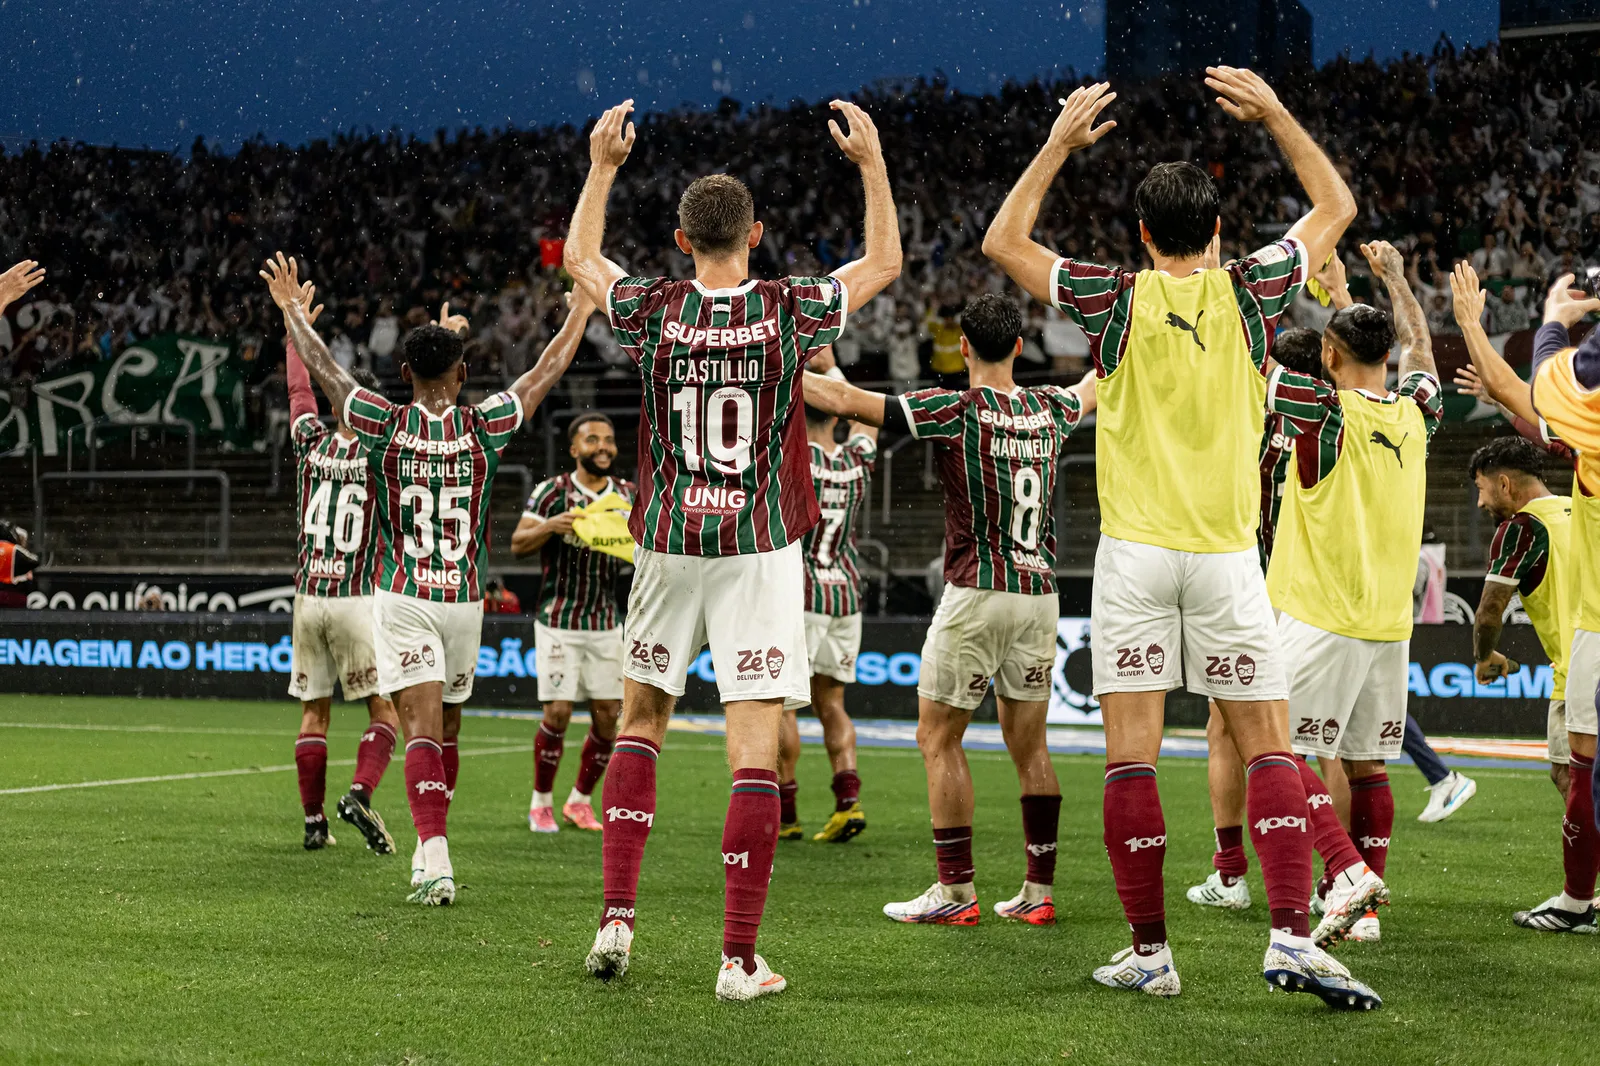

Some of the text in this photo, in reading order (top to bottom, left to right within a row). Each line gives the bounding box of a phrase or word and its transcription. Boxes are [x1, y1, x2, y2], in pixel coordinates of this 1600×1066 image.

[664, 319, 777, 347] SUPERBET
[675, 359, 759, 382] CASTILLO
[715, 391, 745, 399] predialnet
[980, 409, 1052, 430] SUPERBET
[672, 386, 754, 474] 19
[394, 430, 475, 455] SUPERBET
[402, 459, 471, 478] HERCULES
[684, 487, 746, 508] UNIG
[304, 480, 368, 553] 46
[681, 506, 722, 514] UNIVERSIDADE
[1011, 467, 1041, 550] 8
[400, 484, 473, 562] 35
[309, 558, 346, 575] UNIG
[1010, 550, 1049, 569] UNIG
[413, 567, 461, 585] UNIG
[138, 640, 191, 670] AO
[196, 635, 293, 673] HERÓ
[400, 649, 422, 668] Zé
[631, 639, 650, 663] Zé
[1116, 646, 1145, 670] Zé
[631, 659, 652, 670] DELIVERY
[736, 649, 764, 673] Zé
[1205, 655, 1233, 678] Zé
[736, 673, 764, 681] DELIVERY
[968, 673, 990, 692] Zé
[1025, 666, 1045, 682] Zé
[1117, 669, 1145, 678] DELIVERY
[1206, 677, 1234, 685] DELIVERY
[1297, 717, 1322, 735] Zé
[1380, 721, 1403, 739] Zé
[415, 780, 447, 794] 100
[606, 806, 655, 828] 1001
[1255, 815, 1307, 836] 1001
[1124, 833, 1167, 853] 100
[605, 906, 635, 918] PRO
[1139, 943, 1164, 953] PR
